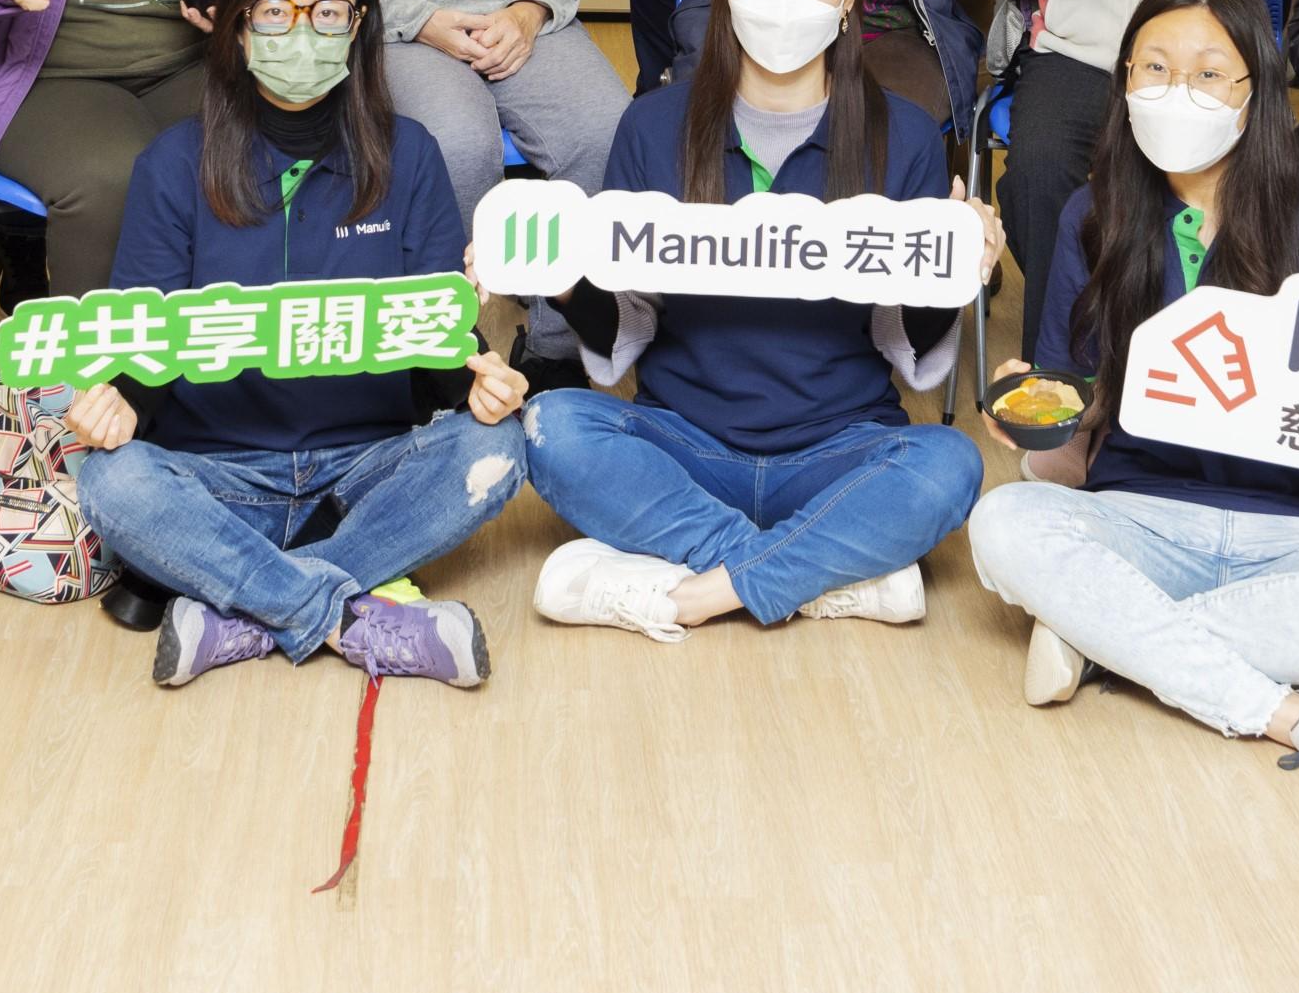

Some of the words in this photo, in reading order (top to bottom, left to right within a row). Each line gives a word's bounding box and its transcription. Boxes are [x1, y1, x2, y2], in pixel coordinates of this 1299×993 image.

[611, 220, 829, 271] Manulife
[843, 226, 954, 279] 宏利
[10, 288, 463, 378] #共享關愛
